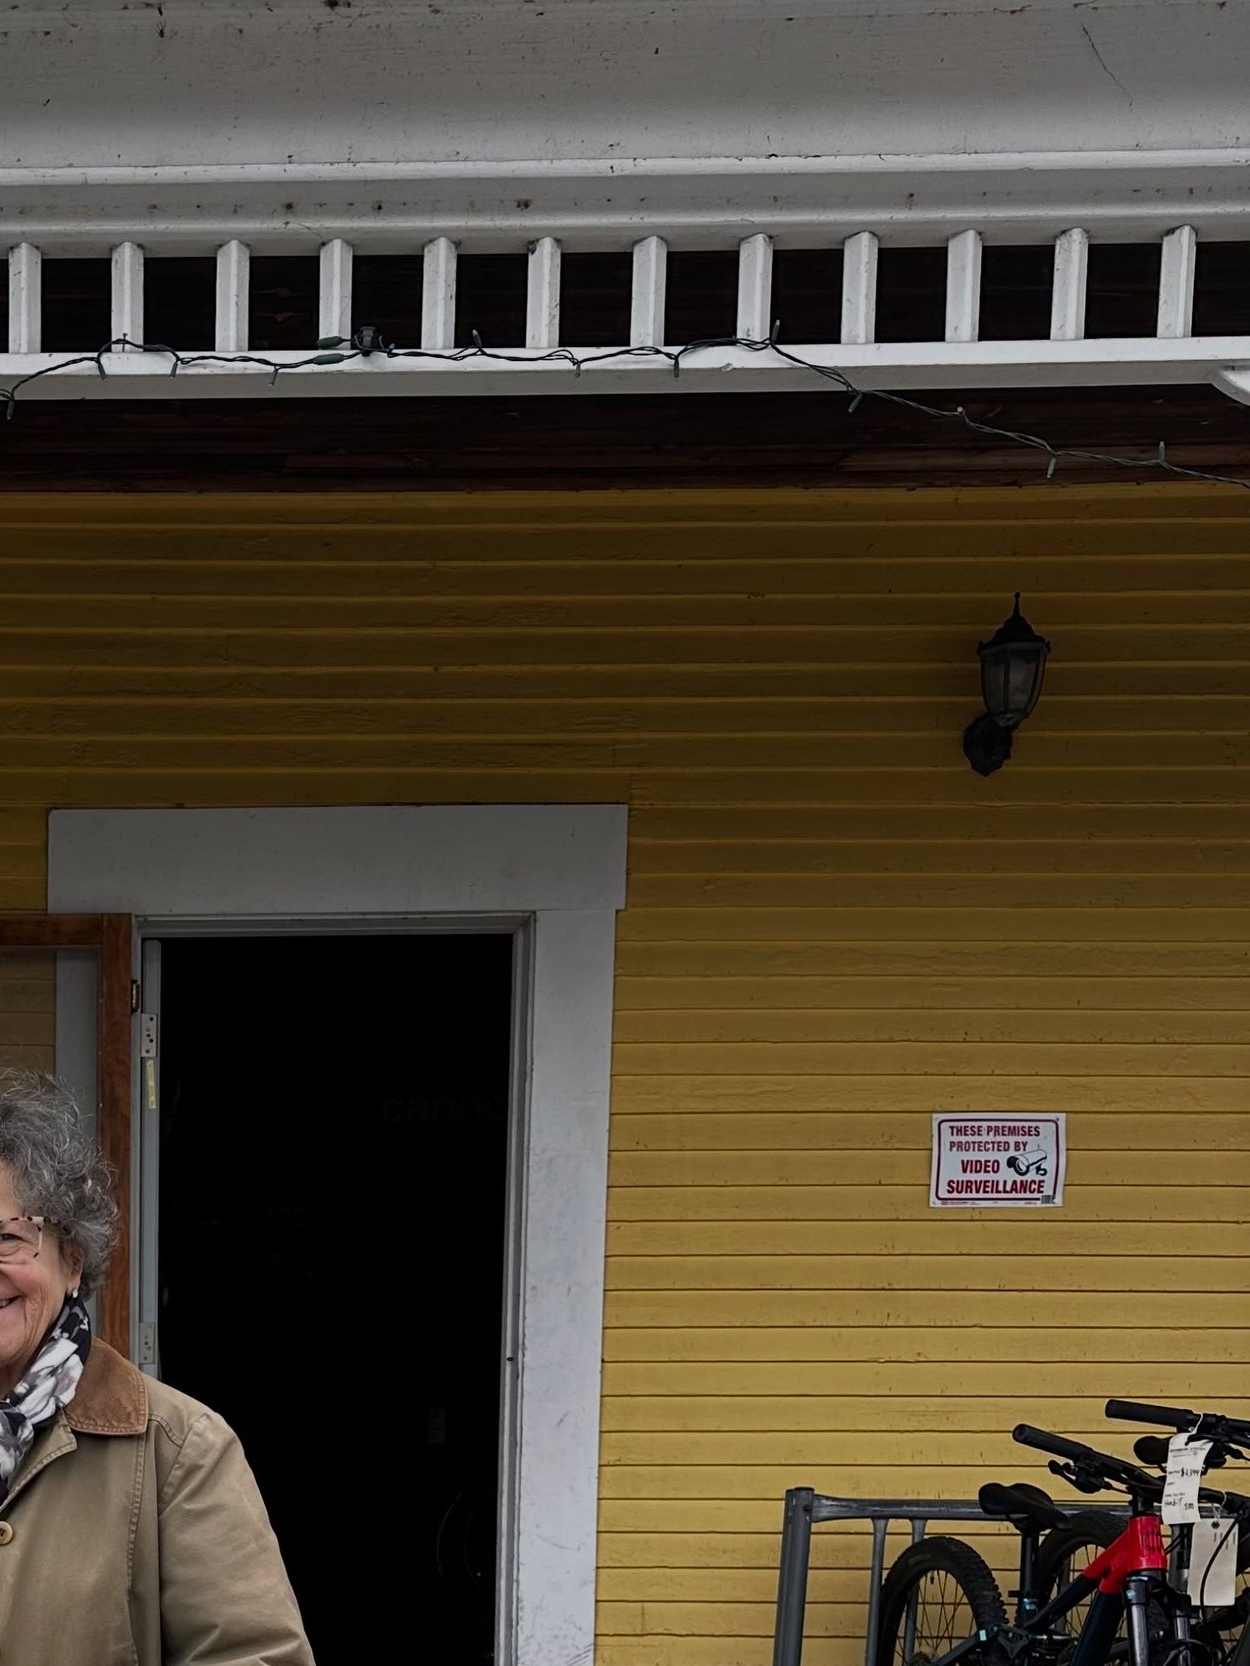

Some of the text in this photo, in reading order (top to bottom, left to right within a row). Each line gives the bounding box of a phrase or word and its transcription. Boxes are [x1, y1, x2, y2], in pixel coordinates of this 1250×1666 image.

[949, 1125, 1040, 1137] THESE PREMISES
[950, 1141, 1028, 1152] PROTECTED BY
[961, 1159, 1000, 1174] VIDEO
[947, 1179, 1045, 1194] SURVEILLANCE
